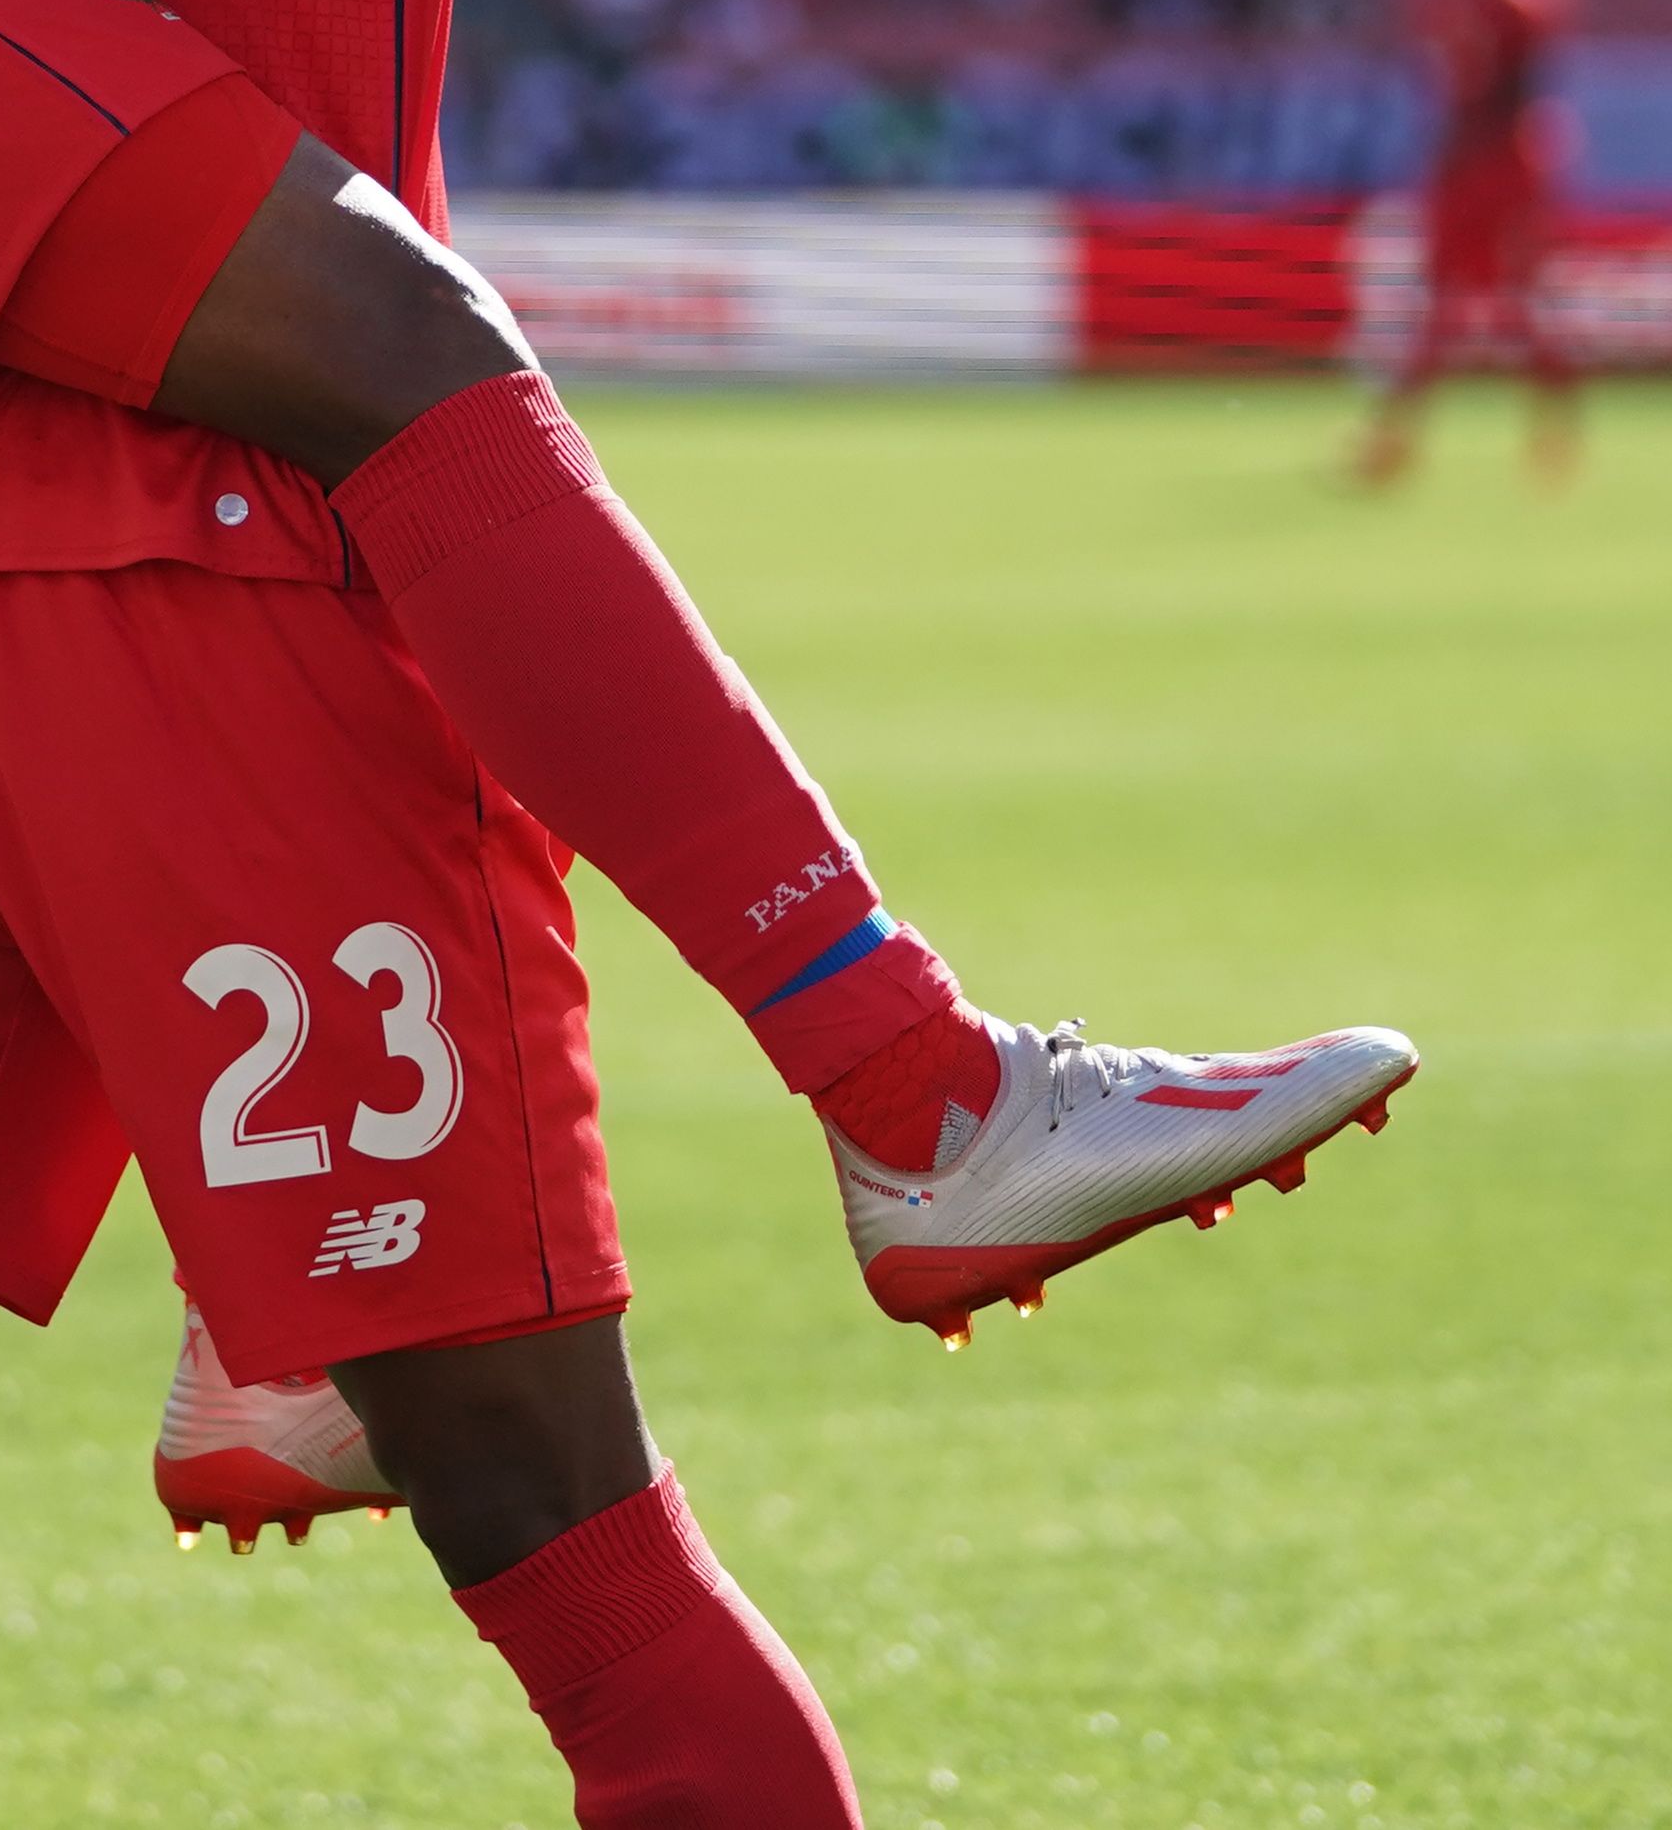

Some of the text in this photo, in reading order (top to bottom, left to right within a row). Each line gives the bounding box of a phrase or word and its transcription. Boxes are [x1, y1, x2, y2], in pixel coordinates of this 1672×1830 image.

[181, 921, 464, 1188] 23
[849, 1170, 906, 1200] QUINTERO
[308, 1198, 426, 1277] NB
